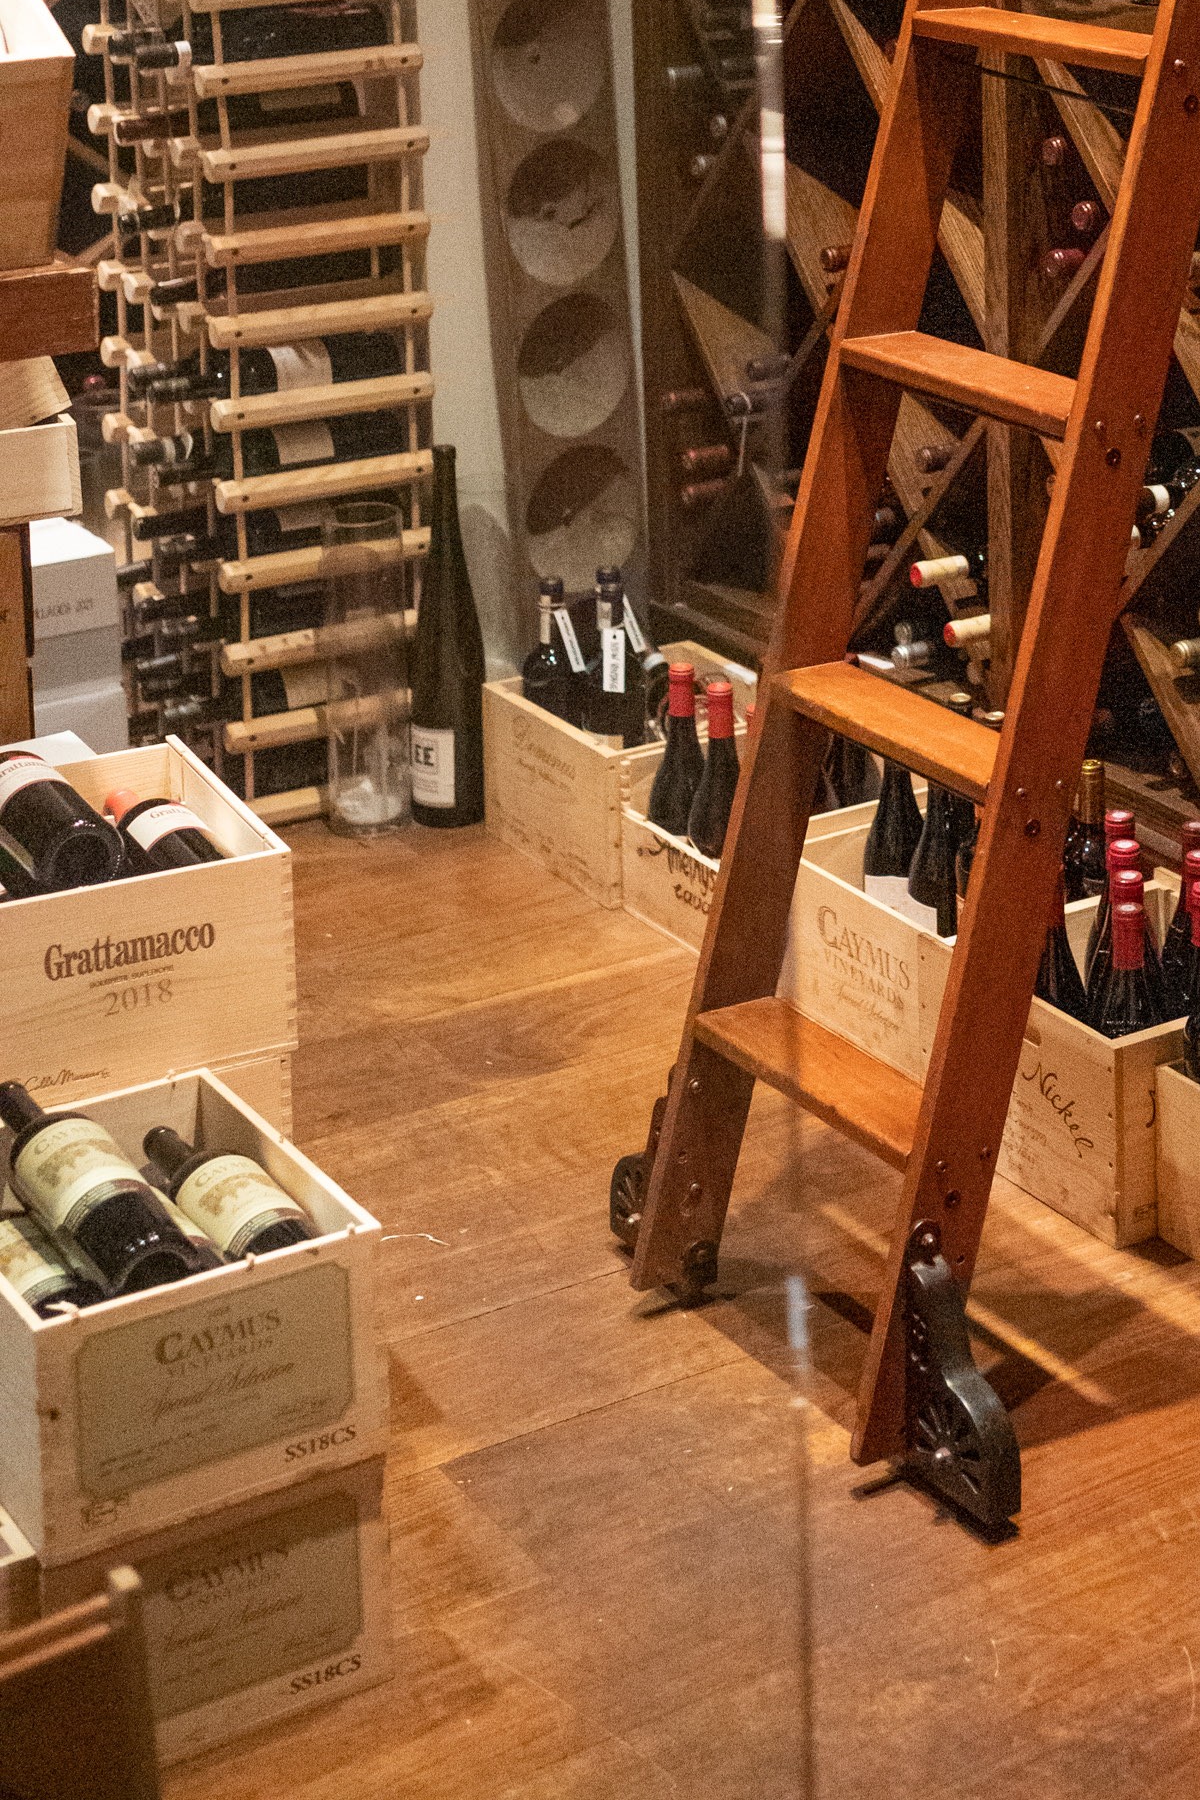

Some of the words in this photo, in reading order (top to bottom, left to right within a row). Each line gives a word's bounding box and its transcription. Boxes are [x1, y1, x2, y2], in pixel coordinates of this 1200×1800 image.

[43, 922, 216, 981] Grattamacco
[818, 906, 911, 991] CAYMUS
[104, 978, 174, 1017] 2018
[1022, 1060, 1095, 1161] Nickel
[154, 1308, 283, 1365] CAYMUS
[284, 1424, 356, 1463] SS18CS
[290, 1653, 362, 1695] SS18CS
